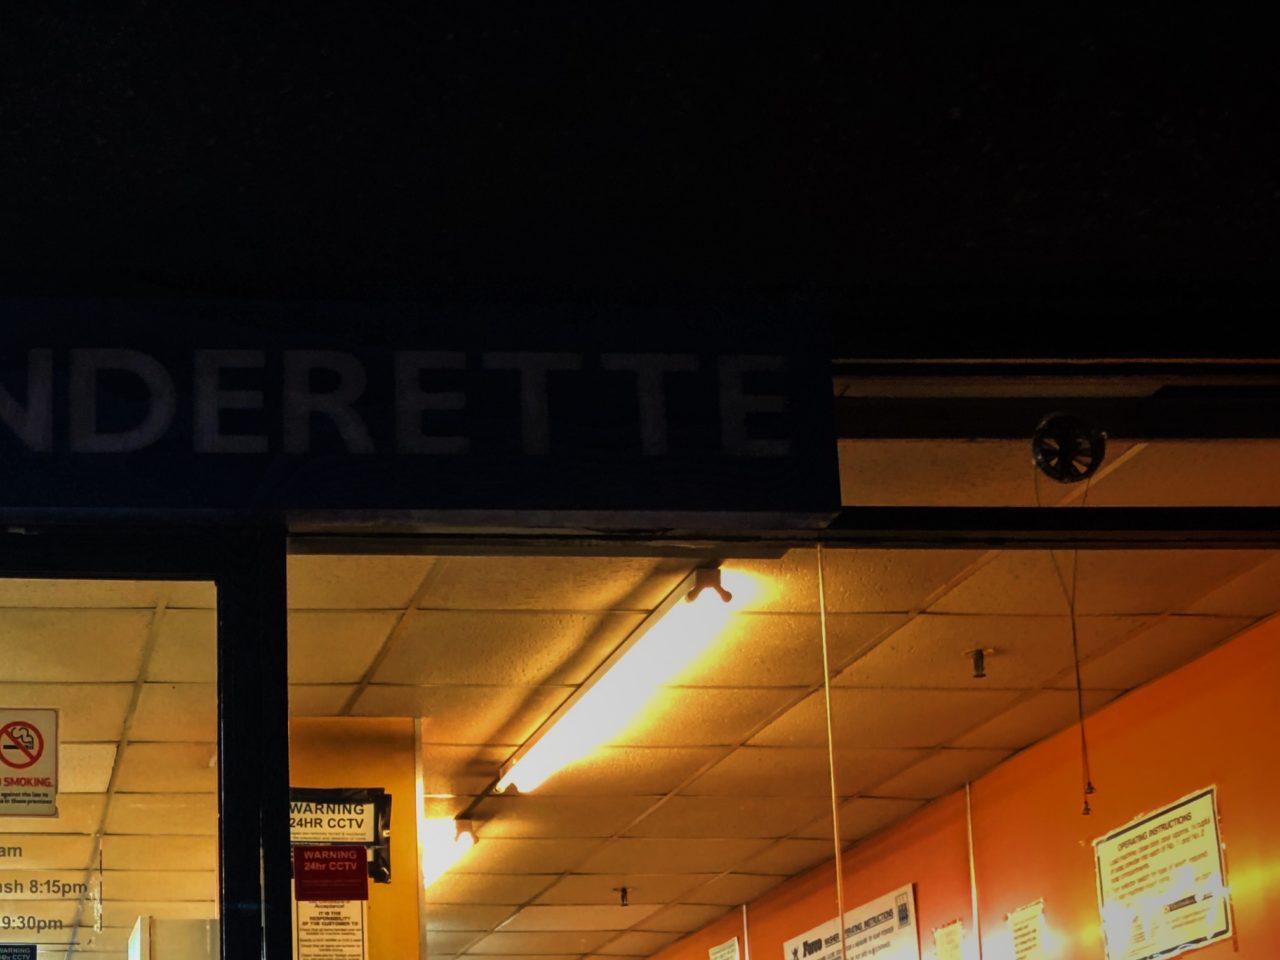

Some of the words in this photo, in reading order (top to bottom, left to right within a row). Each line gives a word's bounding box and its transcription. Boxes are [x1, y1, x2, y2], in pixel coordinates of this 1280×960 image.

[290, 803, 365, 815] WARNING
[290, 818, 323, 829] 24HR
[327, 818, 364, 829] CCTV
[303, 850, 358, 860] WARNING
[304, 862, 327, 871] 24hr
[328, 862, 358, 871] CCTV
[29, 880, 88, 897] 8:15pm
[2, 916, 63, 934] 9:30pm
